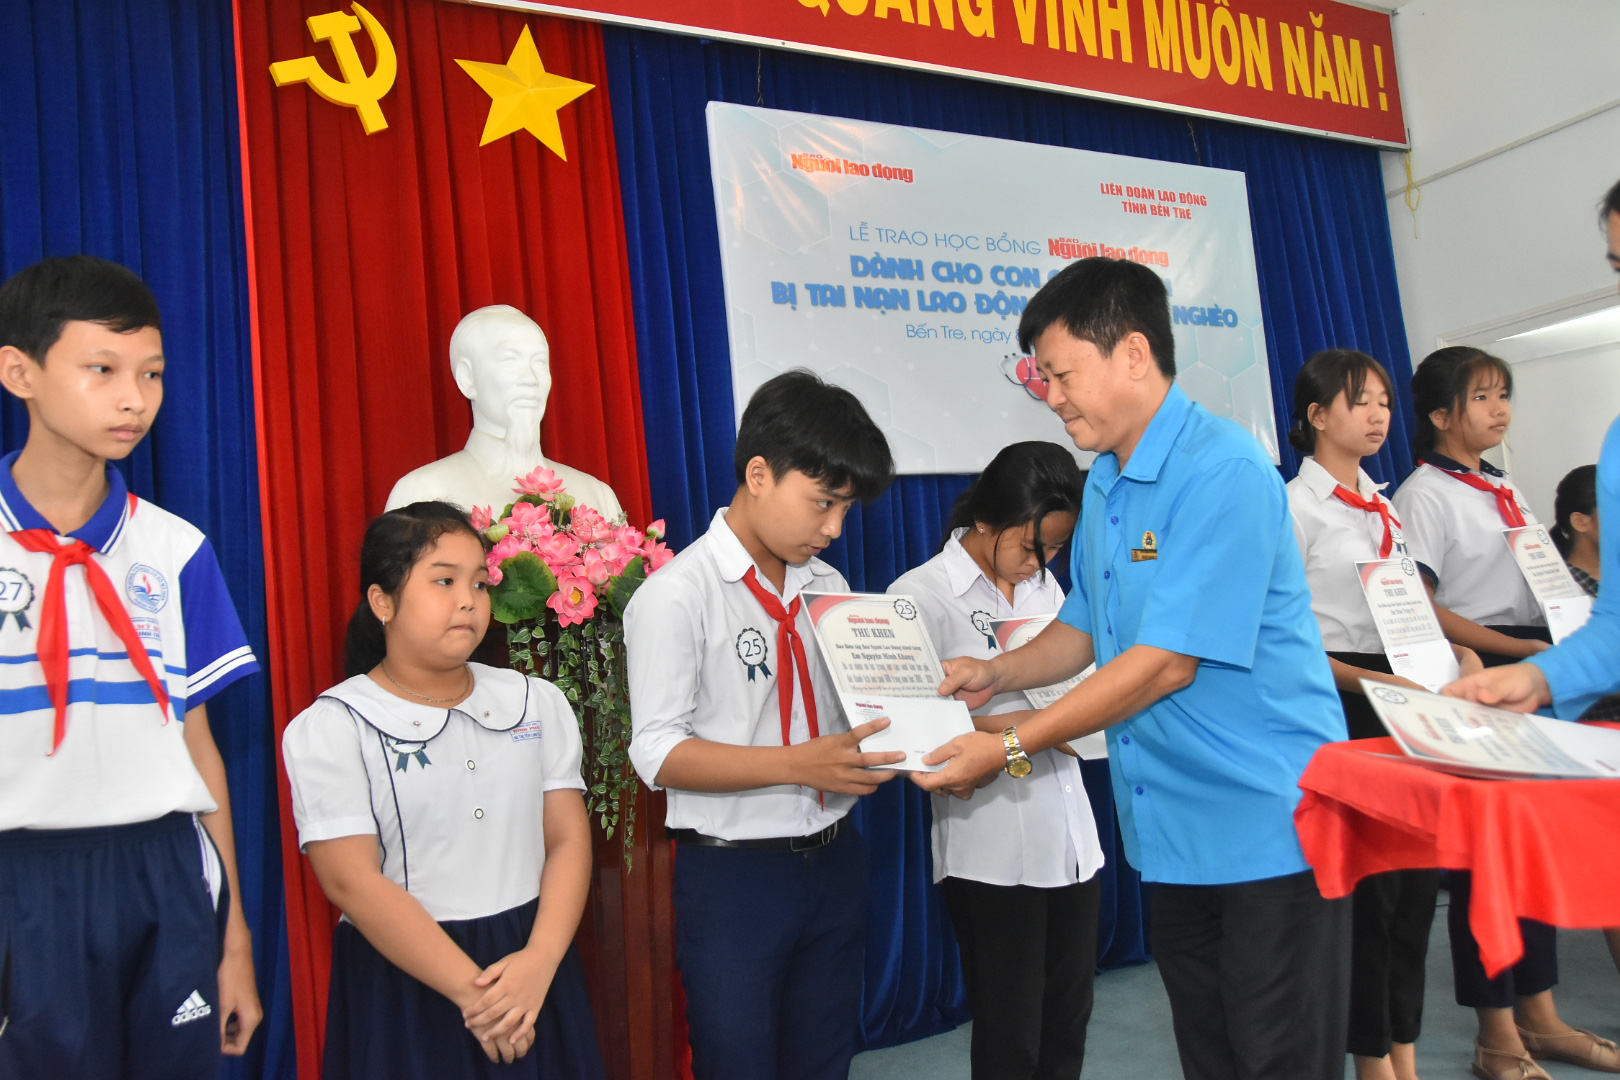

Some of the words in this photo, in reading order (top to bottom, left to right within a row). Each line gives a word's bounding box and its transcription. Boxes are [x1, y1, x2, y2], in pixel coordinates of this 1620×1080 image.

[1012, 0, 1133, 63] VINH
[1142, 0, 1273, 91] MUÔN
[1279, 11, 1370, 109] NĂM
[843, 159, 870, 177] lao
[1100, 182, 1123, 196] LIÊN
[1158, 190, 1176, 202] LAO
[1173, 206, 1192, 220] TRE
[875, 227, 928, 246] TRAO
[935, 233, 980, 251] HỌC
[986, 232, 1041, 255] BỔNG
[850, 252, 924, 281] DÀNH
[931, 261, 983, 285] CHO
[990, 265, 1041, 288] CON
[771, 281, 797, 310] BỊ
[805, 283, 846, 307] TAI
[853, 286, 910, 314] NẠN
[917, 289, 967, 313] LAO
[975, 290, 1029, 320] ĐỘN
[1172, 304, 1238, 328] NGHÈO
[906, 323, 937, 339] Bến
[940, 325, 967, 341] Tre,
[972, 327, 1011, 344] ngày
[897, 604, 913, 615] 25
[743, 638, 762, 657] 25
[172, 1004, 212, 1026] adidas
